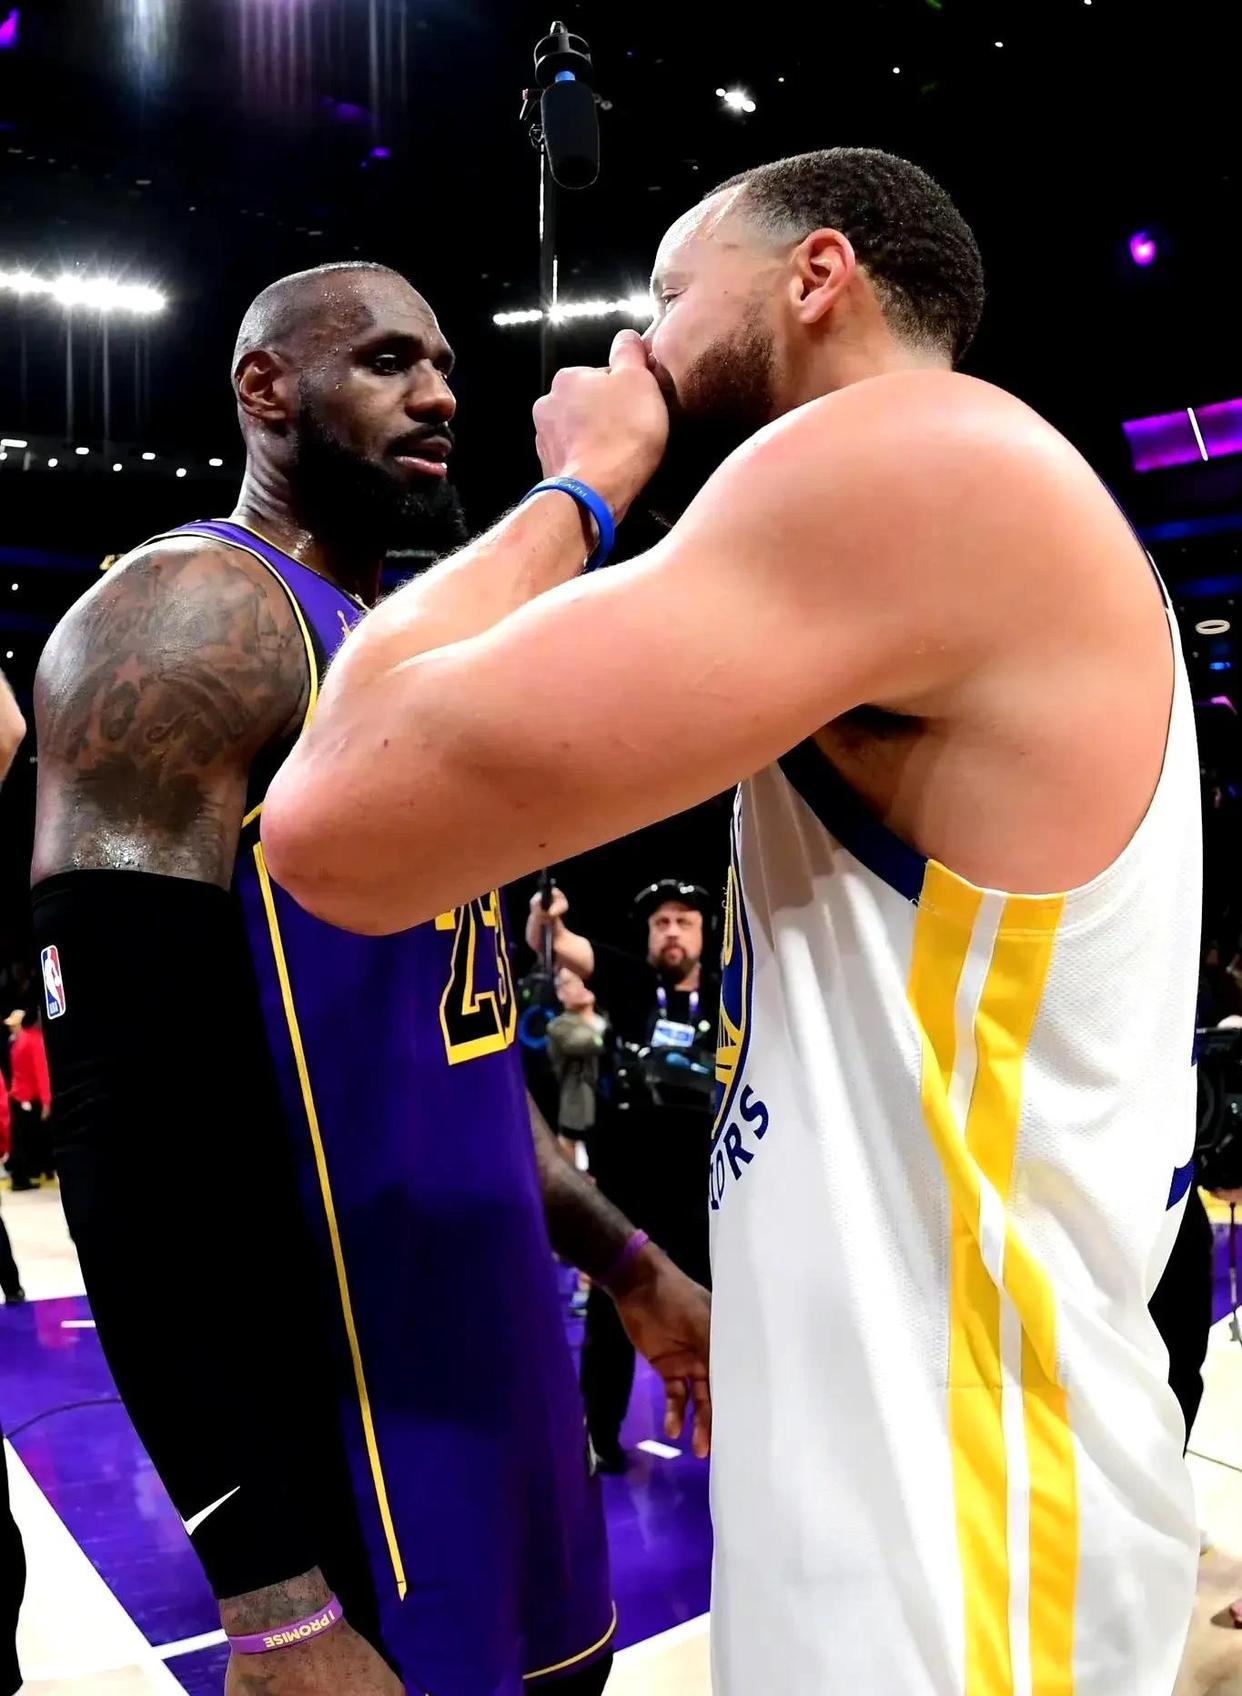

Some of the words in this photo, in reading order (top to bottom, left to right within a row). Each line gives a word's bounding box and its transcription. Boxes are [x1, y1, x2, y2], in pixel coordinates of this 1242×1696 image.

[435, 888, 517, 1066] 23
[262, 1613, 331, 1648] PROMISE
[327, 1609, 336, 1621] I
